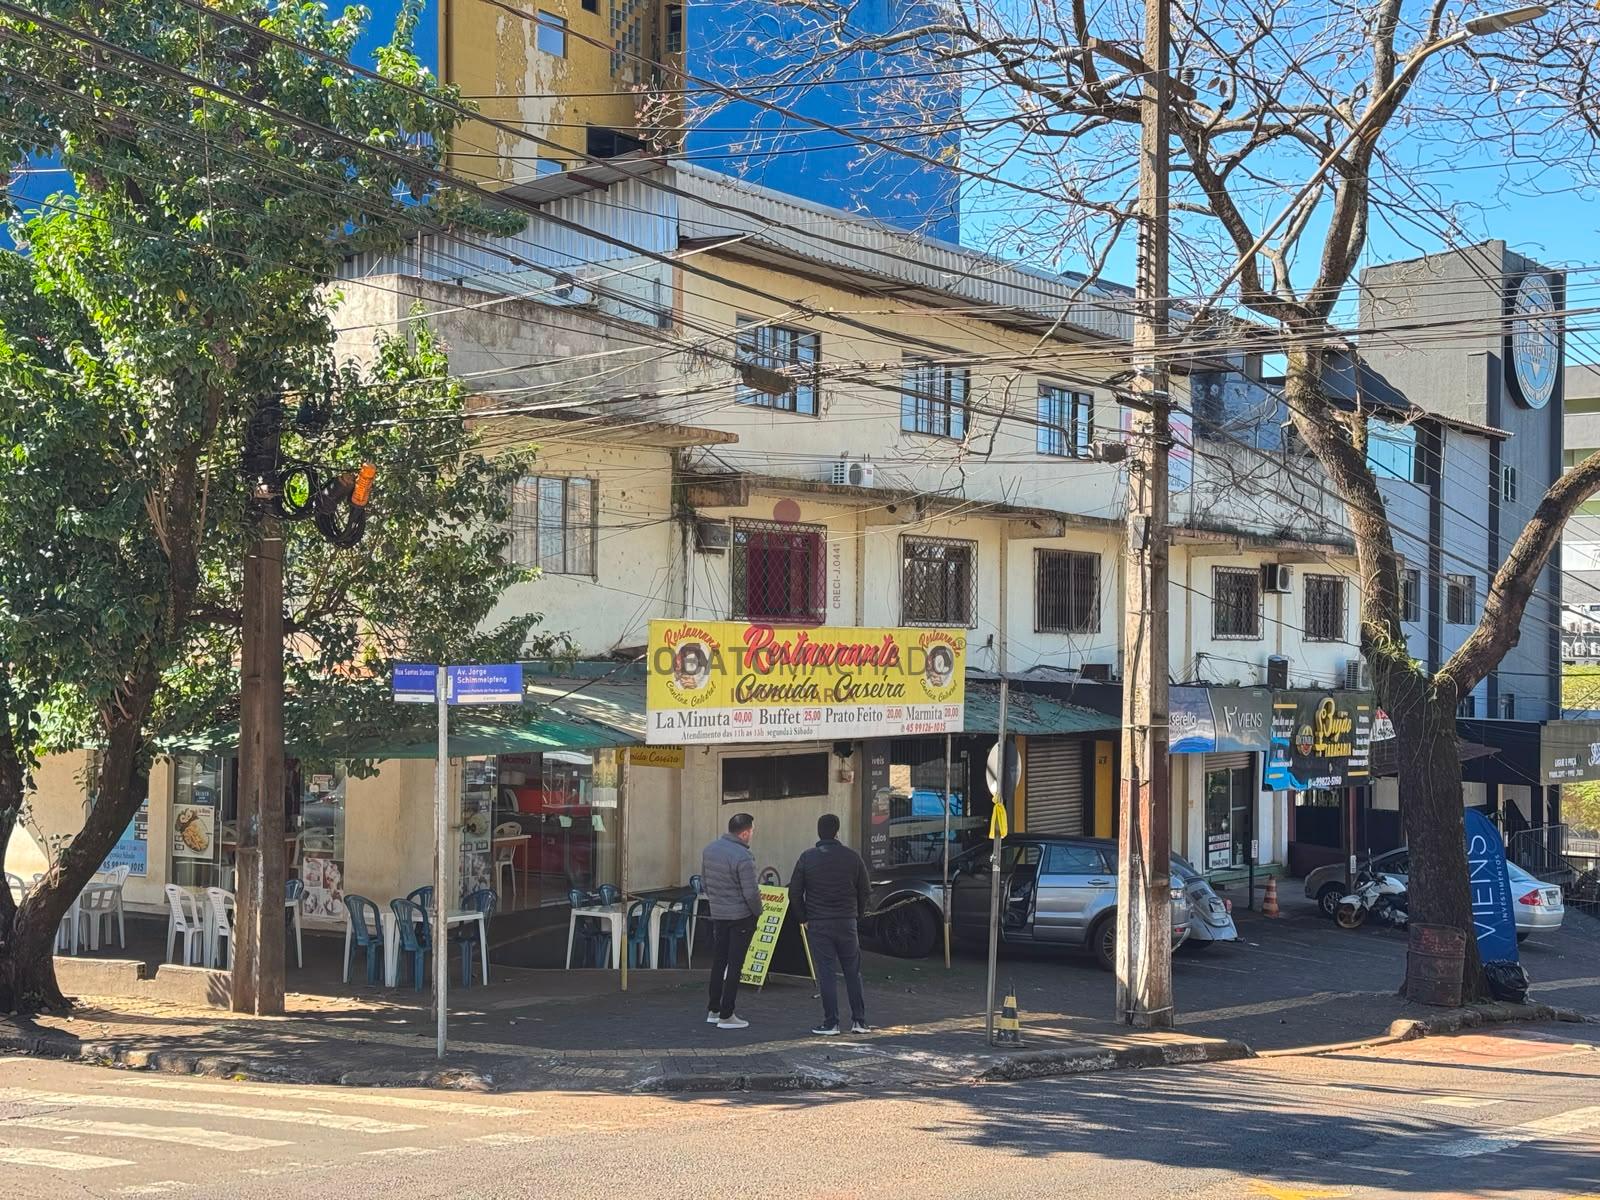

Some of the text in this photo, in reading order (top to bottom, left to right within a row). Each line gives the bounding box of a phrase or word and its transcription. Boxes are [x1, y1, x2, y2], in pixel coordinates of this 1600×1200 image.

[743, 624, 900, 674] Restaurante
[834, 674, 905, 702] Caseira
[656, 712, 674, 729] La
[678, 711, 730, 728] Minuta
[760, 708, 800, 725] Buffet
[825, 707, 854, 723] Prato
[857, 707, 883, 722] Feito
[906, 706, 943, 720] Marmita
[1238, 713, 1262, 727] VIENS
[1467, 835, 1496, 940] VIENS
